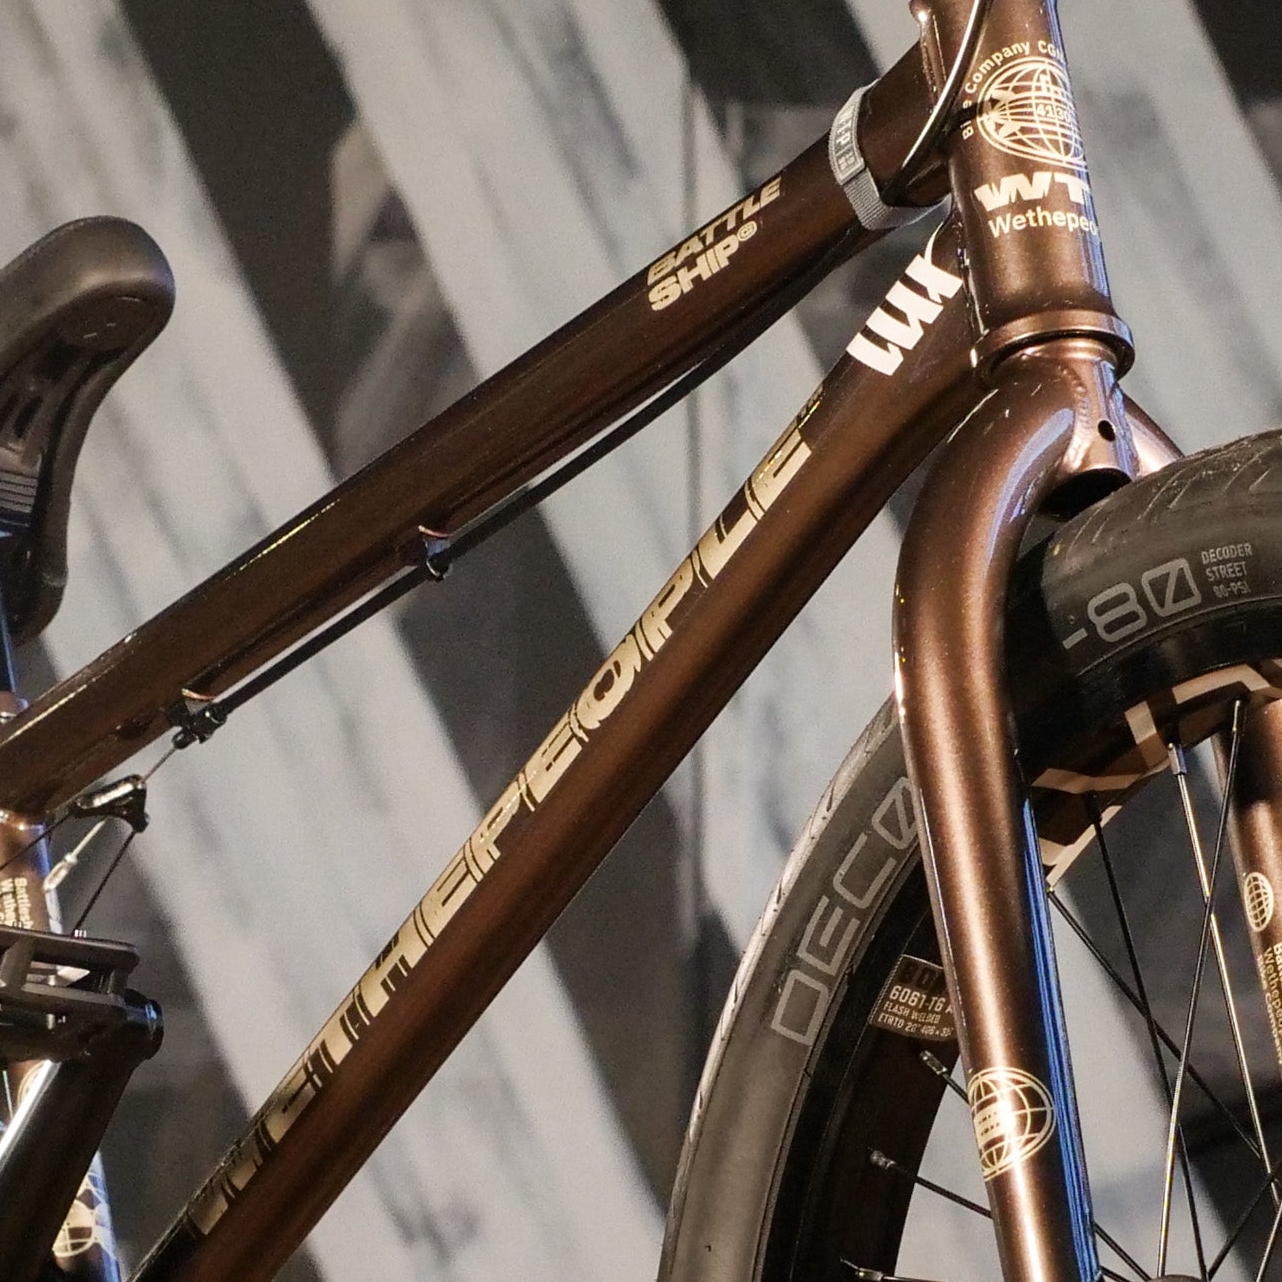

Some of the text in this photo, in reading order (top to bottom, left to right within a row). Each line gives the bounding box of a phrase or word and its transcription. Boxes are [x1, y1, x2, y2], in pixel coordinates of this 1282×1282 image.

[965, 41, 1031, 94] Company
[961, 99, 974, 140] Bie
[647, 175, 782, 286] BATTLE
[1201, 542, 1253, 565] DECODER
[1205, 561, 1248, 582] STREET
[883, 1001, 911, 1017] FLASH
[889, 985, 946, 1013] 6061-T6
[878, 1013, 905, 1029] ETRTO
